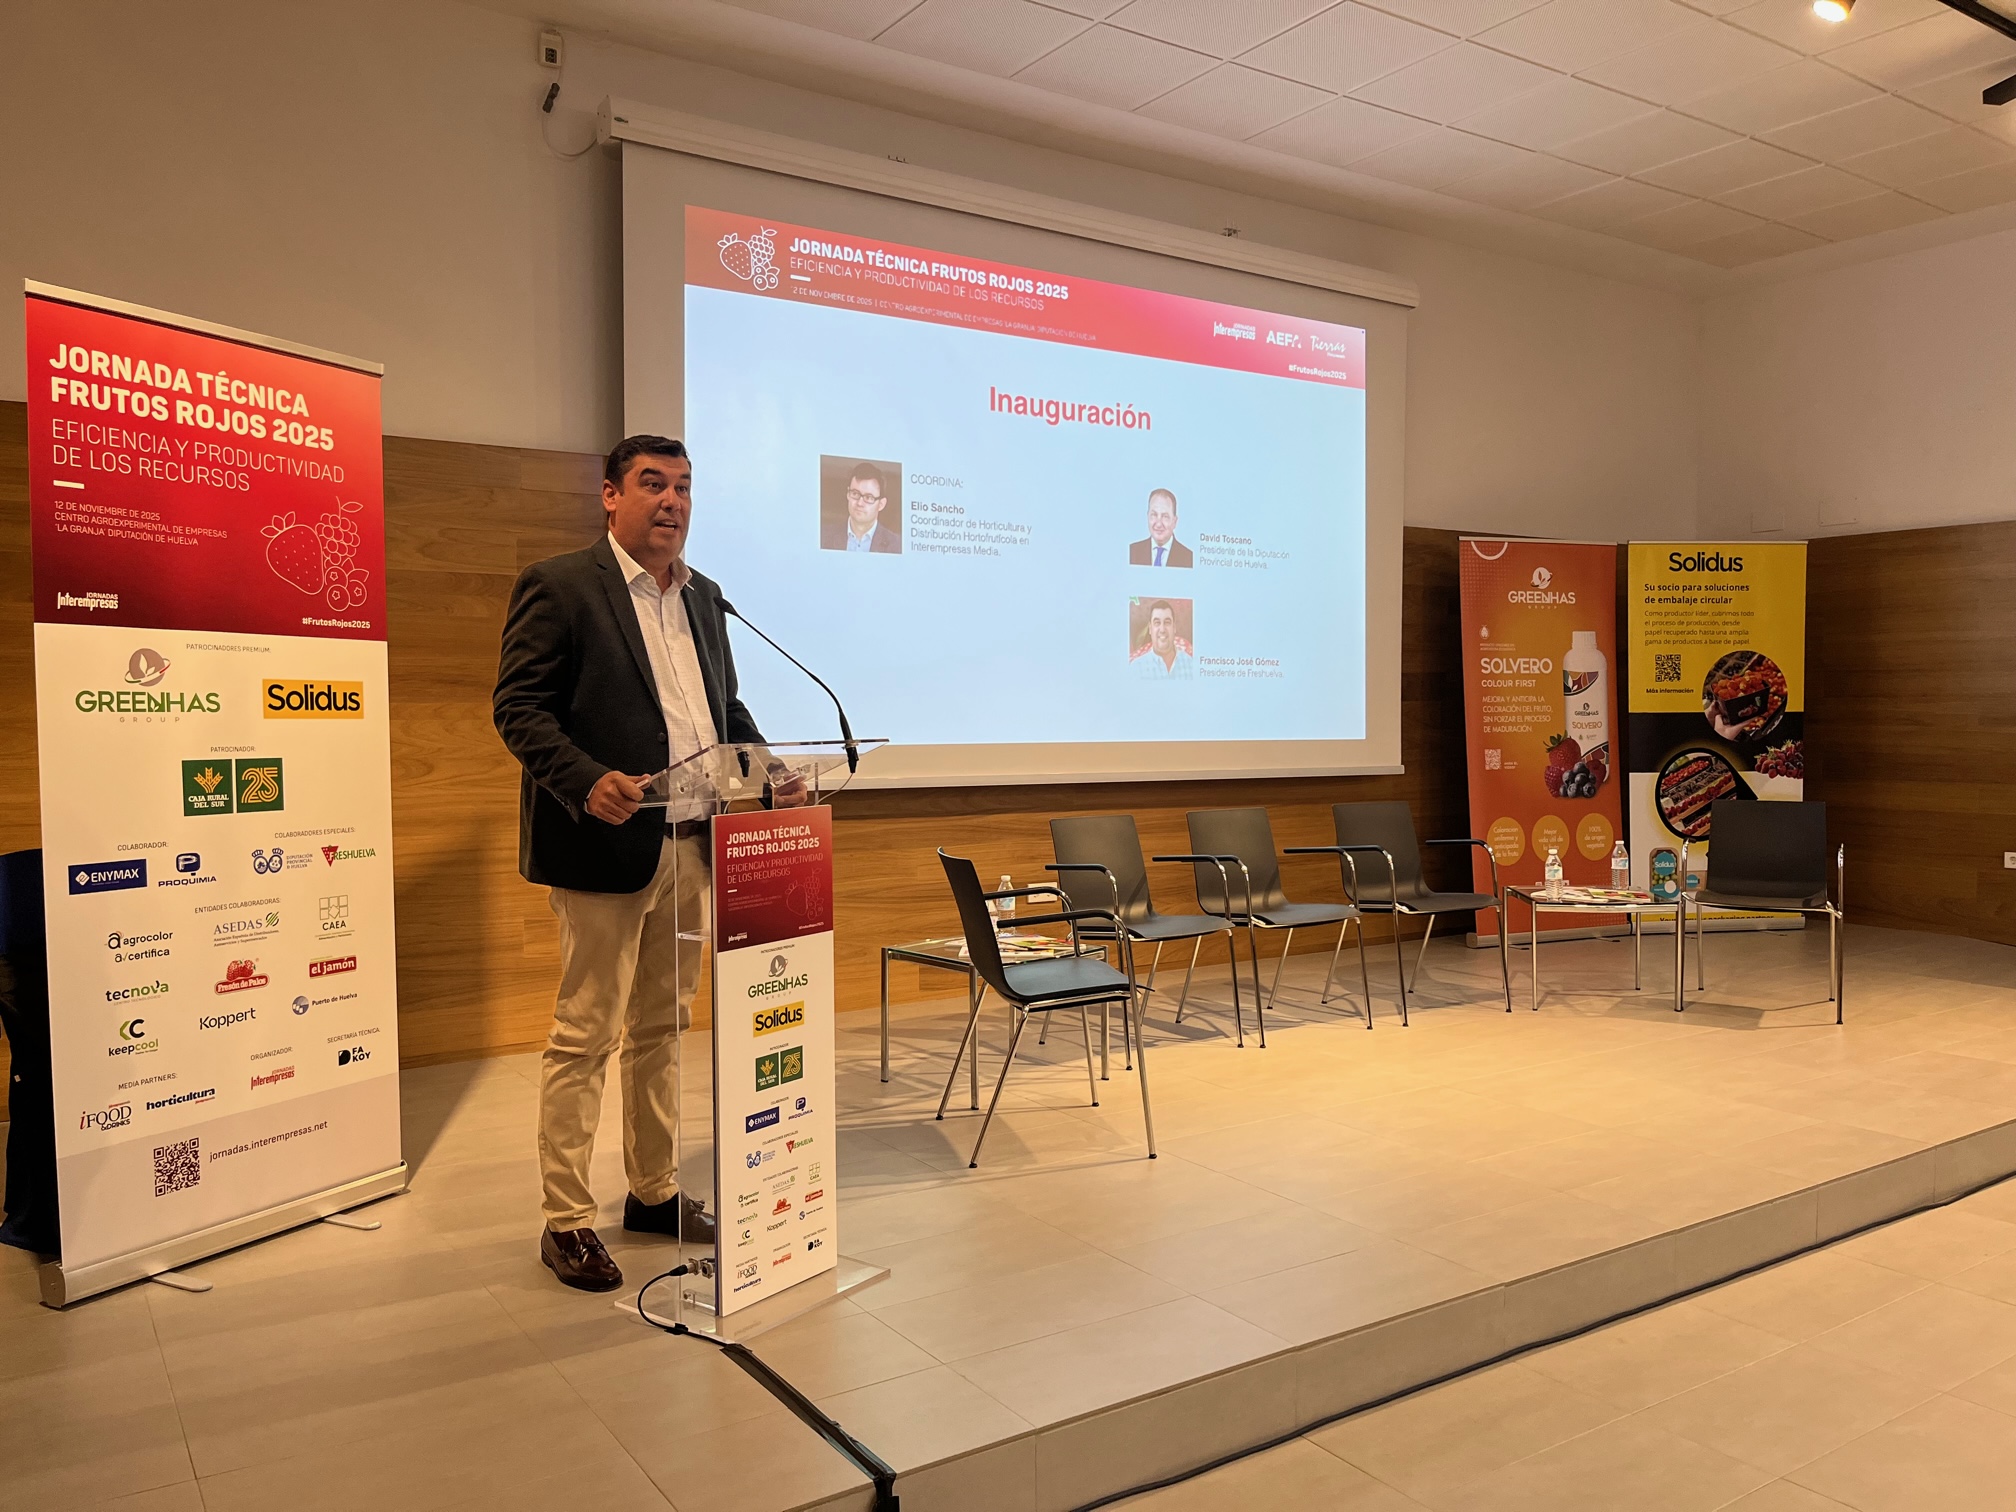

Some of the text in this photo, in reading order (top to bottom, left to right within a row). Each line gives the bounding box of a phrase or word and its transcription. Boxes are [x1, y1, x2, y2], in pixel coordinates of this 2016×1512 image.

[789, 237, 1069, 300] JORNADA TÉCNICA FRUTOS ROJOS 2025
[790, 257, 1044, 311] EFICIENCIA Y PRODUCTIVIDAD DE LOS RECURSOS
[1213, 321, 1256, 341] Interempresas
[1310, 335, 1347, 352] Tierras
[1288, 364, 1347, 380] #FrutosRojos2025
[49, 343, 310, 418] JORNADA TÉCNICA
[51, 376, 334, 451] FRUTOS ROJOS 2025
[989, 386, 1152, 431] Inauguración
[52, 419, 344, 484] EFICIENCIA Y PRODUCTIVIDAD
[53, 445, 250, 492] DE LOS RECURSOS
[911, 474, 964, 488] COORDINA:
[54, 500, 161, 521] 12 DE NOVIEMBRE DE 2025
[911, 501, 965, 514] Elio Sancho
[54, 512, 228, 539] CENTRO AGROEXPERIMENTAL DE EMPRESAS
[911, 514, 1032, 535] Coordinador de Horticultura y
[108, 528, 154, 542] DIPUTACIÓN
[155, 533, 166, 543] DE
[167, 536, 199, 546] HUELVA
[911, 528, 1030, 545] Distribución Hortofrutícola en
[1200, 533, 1252, 545] David Toscano
[911, 541, 1001, 557] Interempresas Media.
[1200, 545, 1236, 556] Presidente
[1237, 548, 1246, 556] de
[1247, 548, 1254, 557] la
[1668, 551, 1743, 572] Solidus
[86, 592, 118, 600] JORNADAS
[1644, 583, 1750, 593] Su socio para soluciones
[57, 592, 119, 611] Interempresas
[1508, 590, 1576, 605] GREENHAS
[1644, 596, 1733, 606] de embalaje circular
[1664, 610, 1694, 619] productor
[302, 617, 371, 629] #FrutosRojos2025
[1652, 620, 1676, 628] proceso
[1644, 629, 1662, 638] papel
[1663, 629, 1698, 637] recuperado
[1728, 629, 1749, 637] amplia
[186, 643, 241, 653] PATROCINADORES
[1200, 656, 1280, 667] Francisco José Gómez
[1480, 657, 1553, 674] SOLVERO
[1481, 679, 1537, 688] COLOUR FIRST
[75, 690, 221, 713] GREENHAS
[267, 683, 361, 712] Solidus
[1482, 695, 1505, 703] MEJORA
[1482, 704, 1521, 713] COLORACIÓN
[1483, 715, 1493, 723] SIN
[1572, 721, 1603, 729] SOLVERO
[241, 767, 279, 804] 25
[188, 793, 229, 803] CAJA RURAL
[210, 800, 225, 808] SUR
[274, 829, 323, 839] COLABORADORES
[726, 824, 811, 845] JORNADA TÉCNICA
[726, 836, 820, 859] FRUTOS ROJOS 2025
[727, 852, 824, 874] EFICIENCIA Y PRODUCTIVIDAD
[91, 868, 139, 883] ENYMAX
[158, 876, 217, 888] PROQUIMIA
[727, 868, 791, 885] DE LOS RECURSOS
[195, 903, 228, 913] ENTIDADES
[213, 918, 263, 935] ASEDAS
[322, 920, 347, 931] CAEA
[123, 931, 174, 946] agrocolor
[311, 957, 355, 975] el jamón
[105, 980, 169, 1002] tecnova
[747, 973, 809, 999] GREENHAS
[311, 998, 331, 1006] Puerto
[339, 992, 358, 1001] Huelva
[200, 1007, 257, 1030] Koppert
[755, 1006, 803, 1032] Solidus
[327, 1031, 358, 1044] SECRETARÍA
[108, 1038, 159, 1056] keepcool
[352, 1046, 364, 1055] FA
[352, 1051, 371, 1063] KOY
[782, 1051, 802, 1078] 25
[118, 1080, 140, 1091] MEDIA
[250, 1069, 295, 1091] Interempresas
[146, 1087, 216, 1111] horticultura
[79, 1104, 132, 1130] iFOOD
[101, 1119, 131, 1131] &DRINKS
[754, 1112, 777, 1125] ENYMAX
[209, 1120, 328, 1163] jornadas.interempresas.net
[766, 1219, 788, 1232] Koppert
